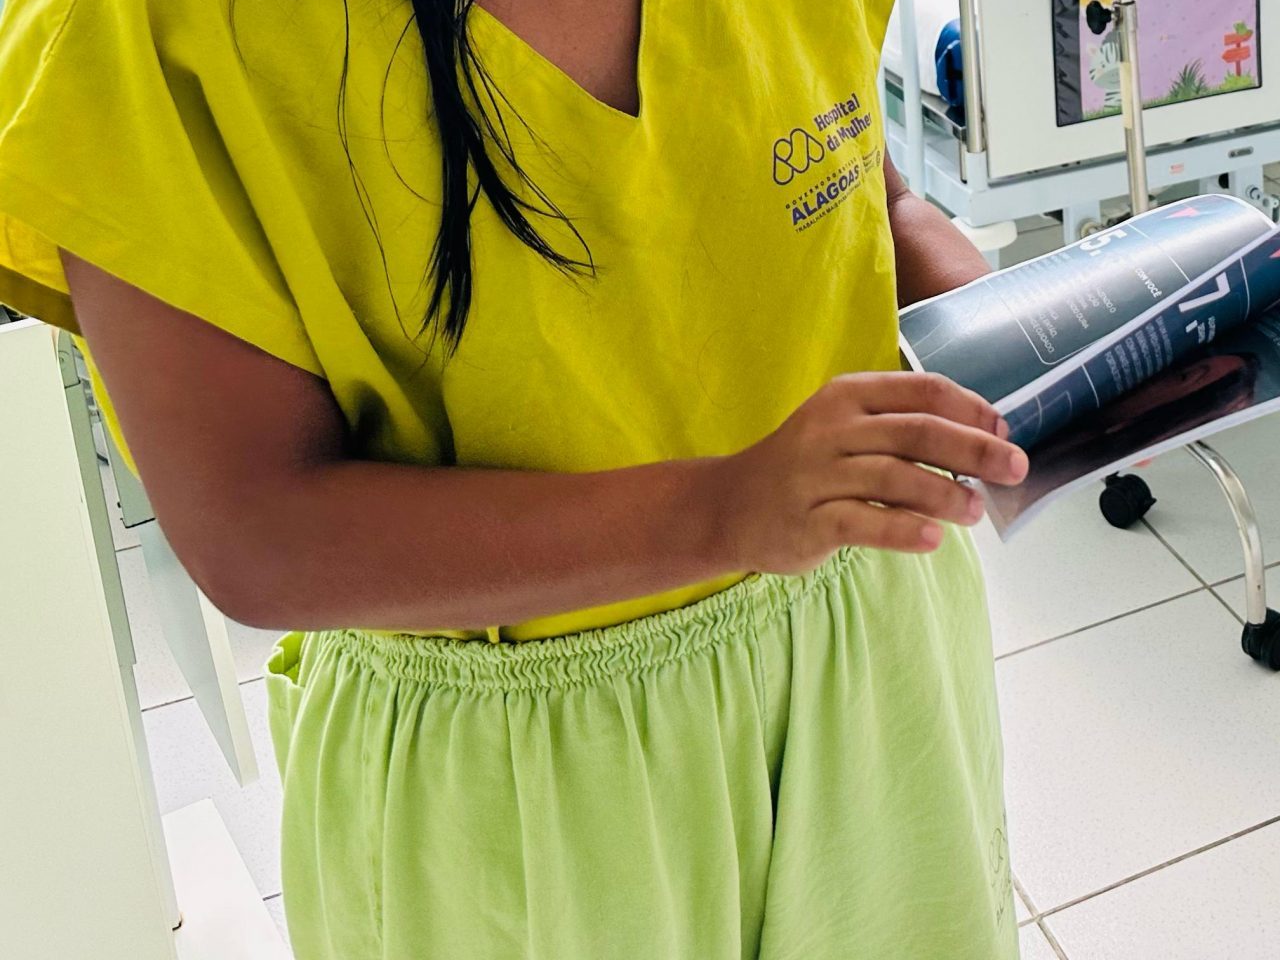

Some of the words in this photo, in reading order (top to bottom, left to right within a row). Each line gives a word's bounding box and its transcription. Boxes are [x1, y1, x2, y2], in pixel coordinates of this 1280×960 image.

[814, 92, 861, 132] Hospital
[826, 135, 840, 152] da
[785, 180, 826, 210] GOVERNO
[792, 164, 861, 226] ALAGOAS
[1144, 279, 1163, 298] VOCÊ
